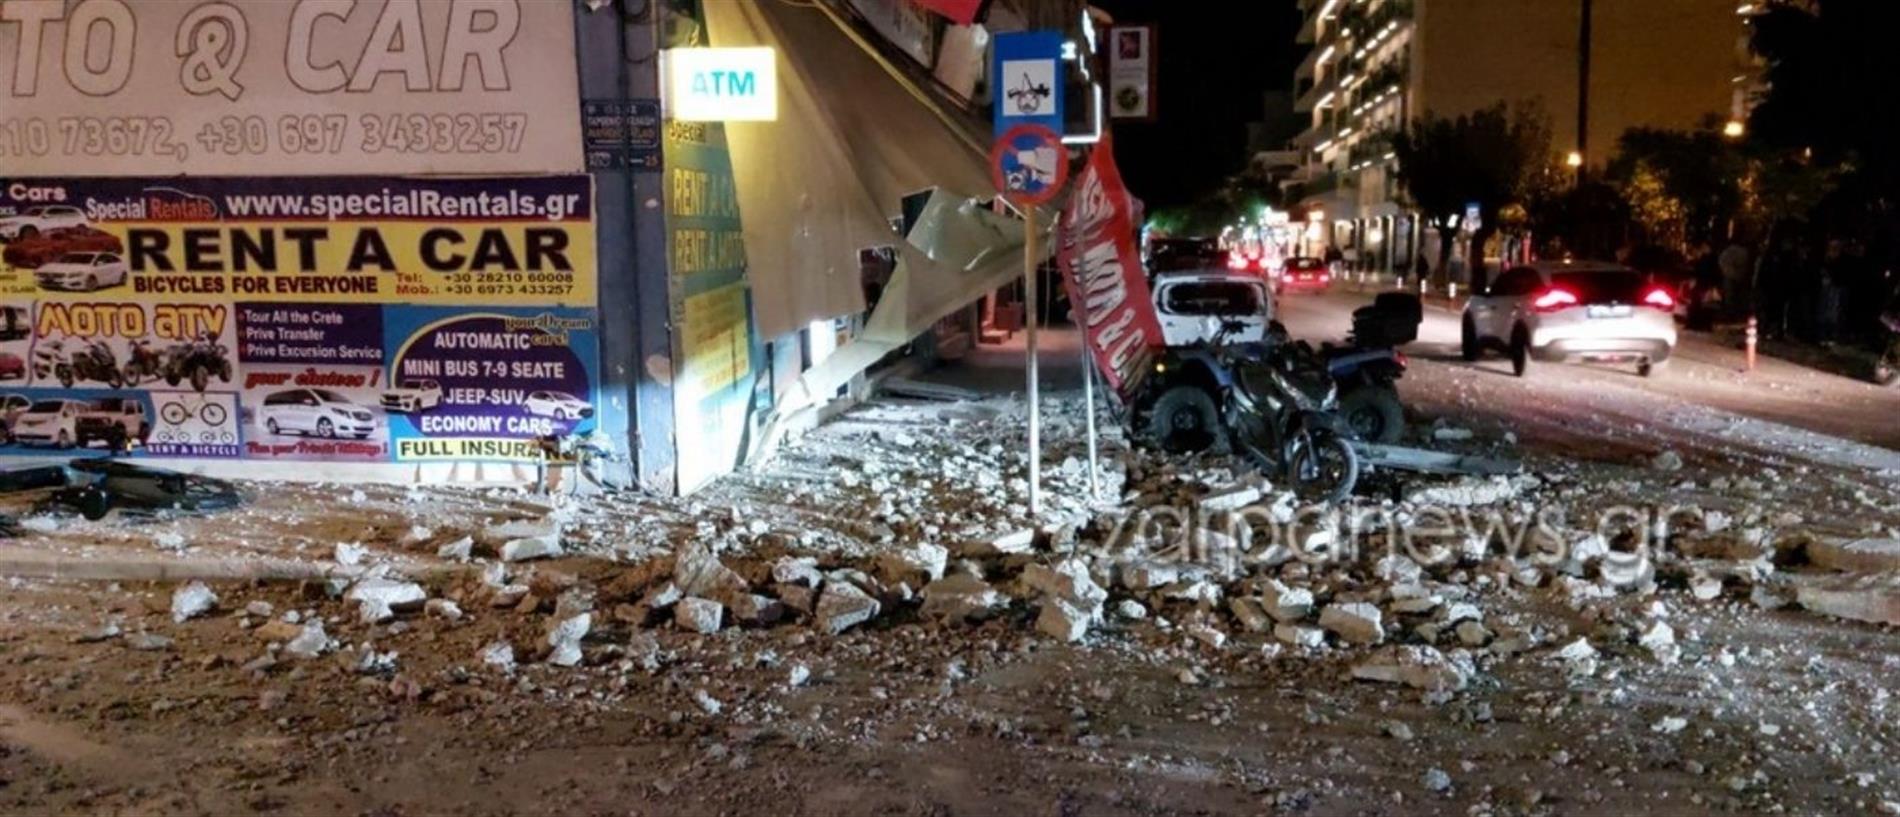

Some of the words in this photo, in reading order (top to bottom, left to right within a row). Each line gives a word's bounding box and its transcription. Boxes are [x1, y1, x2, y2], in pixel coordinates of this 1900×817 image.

[175, 1, 244, 101] &
[284, 0, 522, 93] CAR
[692, 71, 755, 96] ATM
[0, 116, 50, 156] 10
[57, 116, 189, 161] 73672,
[196, 114, 268, 156] +30
[278, 114, 348, 155] 697
[361, 113, 527, 154] 3433257
[9, 183, 67, 202] Cars
[673, 168, 708, 216] RENT
[86, 197, 146, 220] Special
[151, 197, 213, 220] Rentals
[226, 188, 579, 221] www.specialRentals.gr
[128, 227, 327, 272] RENT
[347, 227, 396, 271] A
[419, 226, 574, 272] CAR
[675, 229, 707, 272] RENT
[134, 276, 224, 293] BICYCLES
[232, 277, 270, 293] FOR
[276, 276, 378, 293] EVERYONE
[397, 273, 423, 283] Tel:
[445, 273, 471, 283] +30
[477, 273, 523, 283] 28210
[528, 273, 573, 283] 60008
[446, 286, 473, 295] +30
[477, 285, 515, 295] 6973
[519, 285, 574, 295] 433257
[38, 302, 147, 338] MOTO
[245, 310, 270, 323] Tour
[272, 311, 288, 323] All
[290, 311, 309, 324] the
[311, 312, 343, 324] Crete
[246, 327, 275, 340] Prive
[277, 327, 325, 341] Transfer
[434, 332, 530, 350] AUTOMATIC
[247, 344, 276, 357] Prive
[279, 345, 337, 358] Excursion
[339, 346, 383, 359] Service
[404, 359, 440, 376] MINI
[445, 360, 478, 377] BUS
[483, 361, 507, 377] 7-9
[512, 361, 564, 378] SEATE
[445, 388, 524, 405] JEEP-SUV
[421, 416, 502, 433] ECONOMY
[507, 417, 553, 434] CARS
[401, 441, 453, 456] FULL
